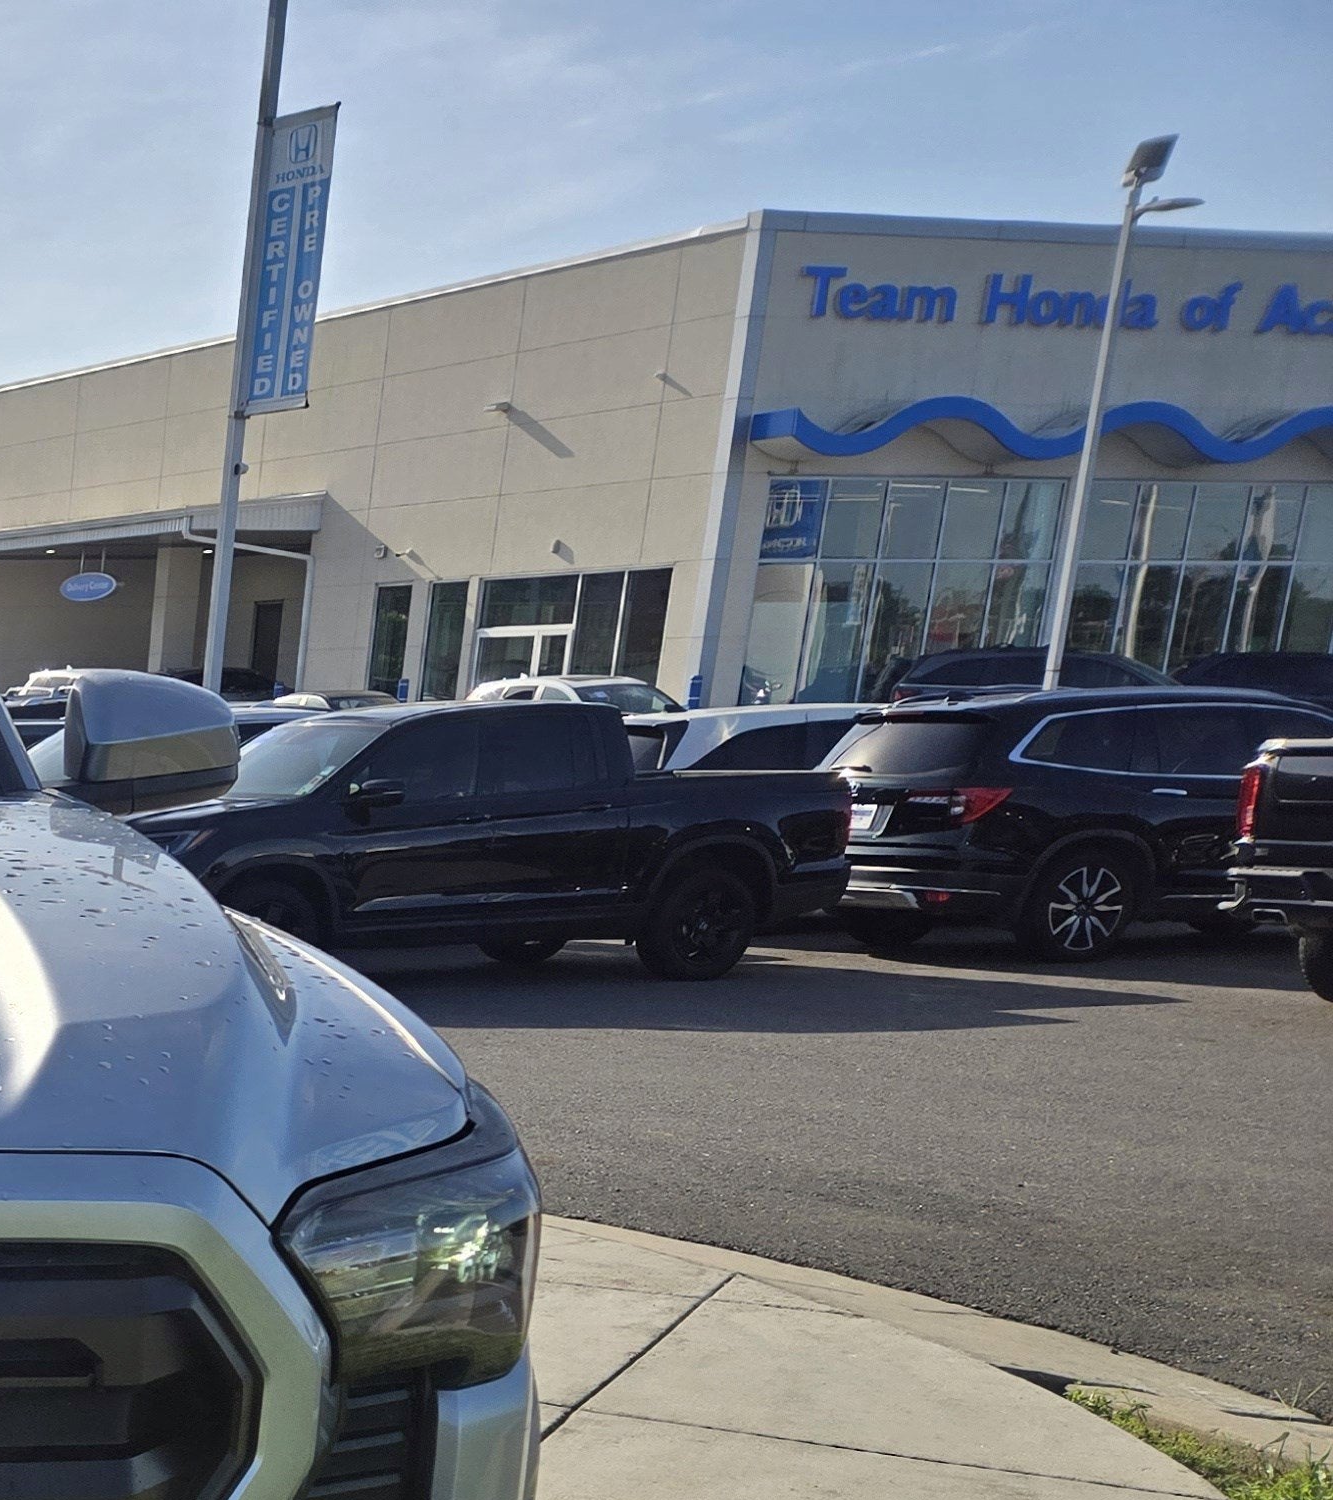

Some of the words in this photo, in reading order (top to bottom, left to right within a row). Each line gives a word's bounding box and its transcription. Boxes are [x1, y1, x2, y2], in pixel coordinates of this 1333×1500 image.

[304, 184, 322, 253] PRE
[253, 193, 291, 396] CERTIFIED
[287, 280, 312, 391] OWNED
[801, 265, 957, 322] Team
[1180, 281, 1244, 332] of
